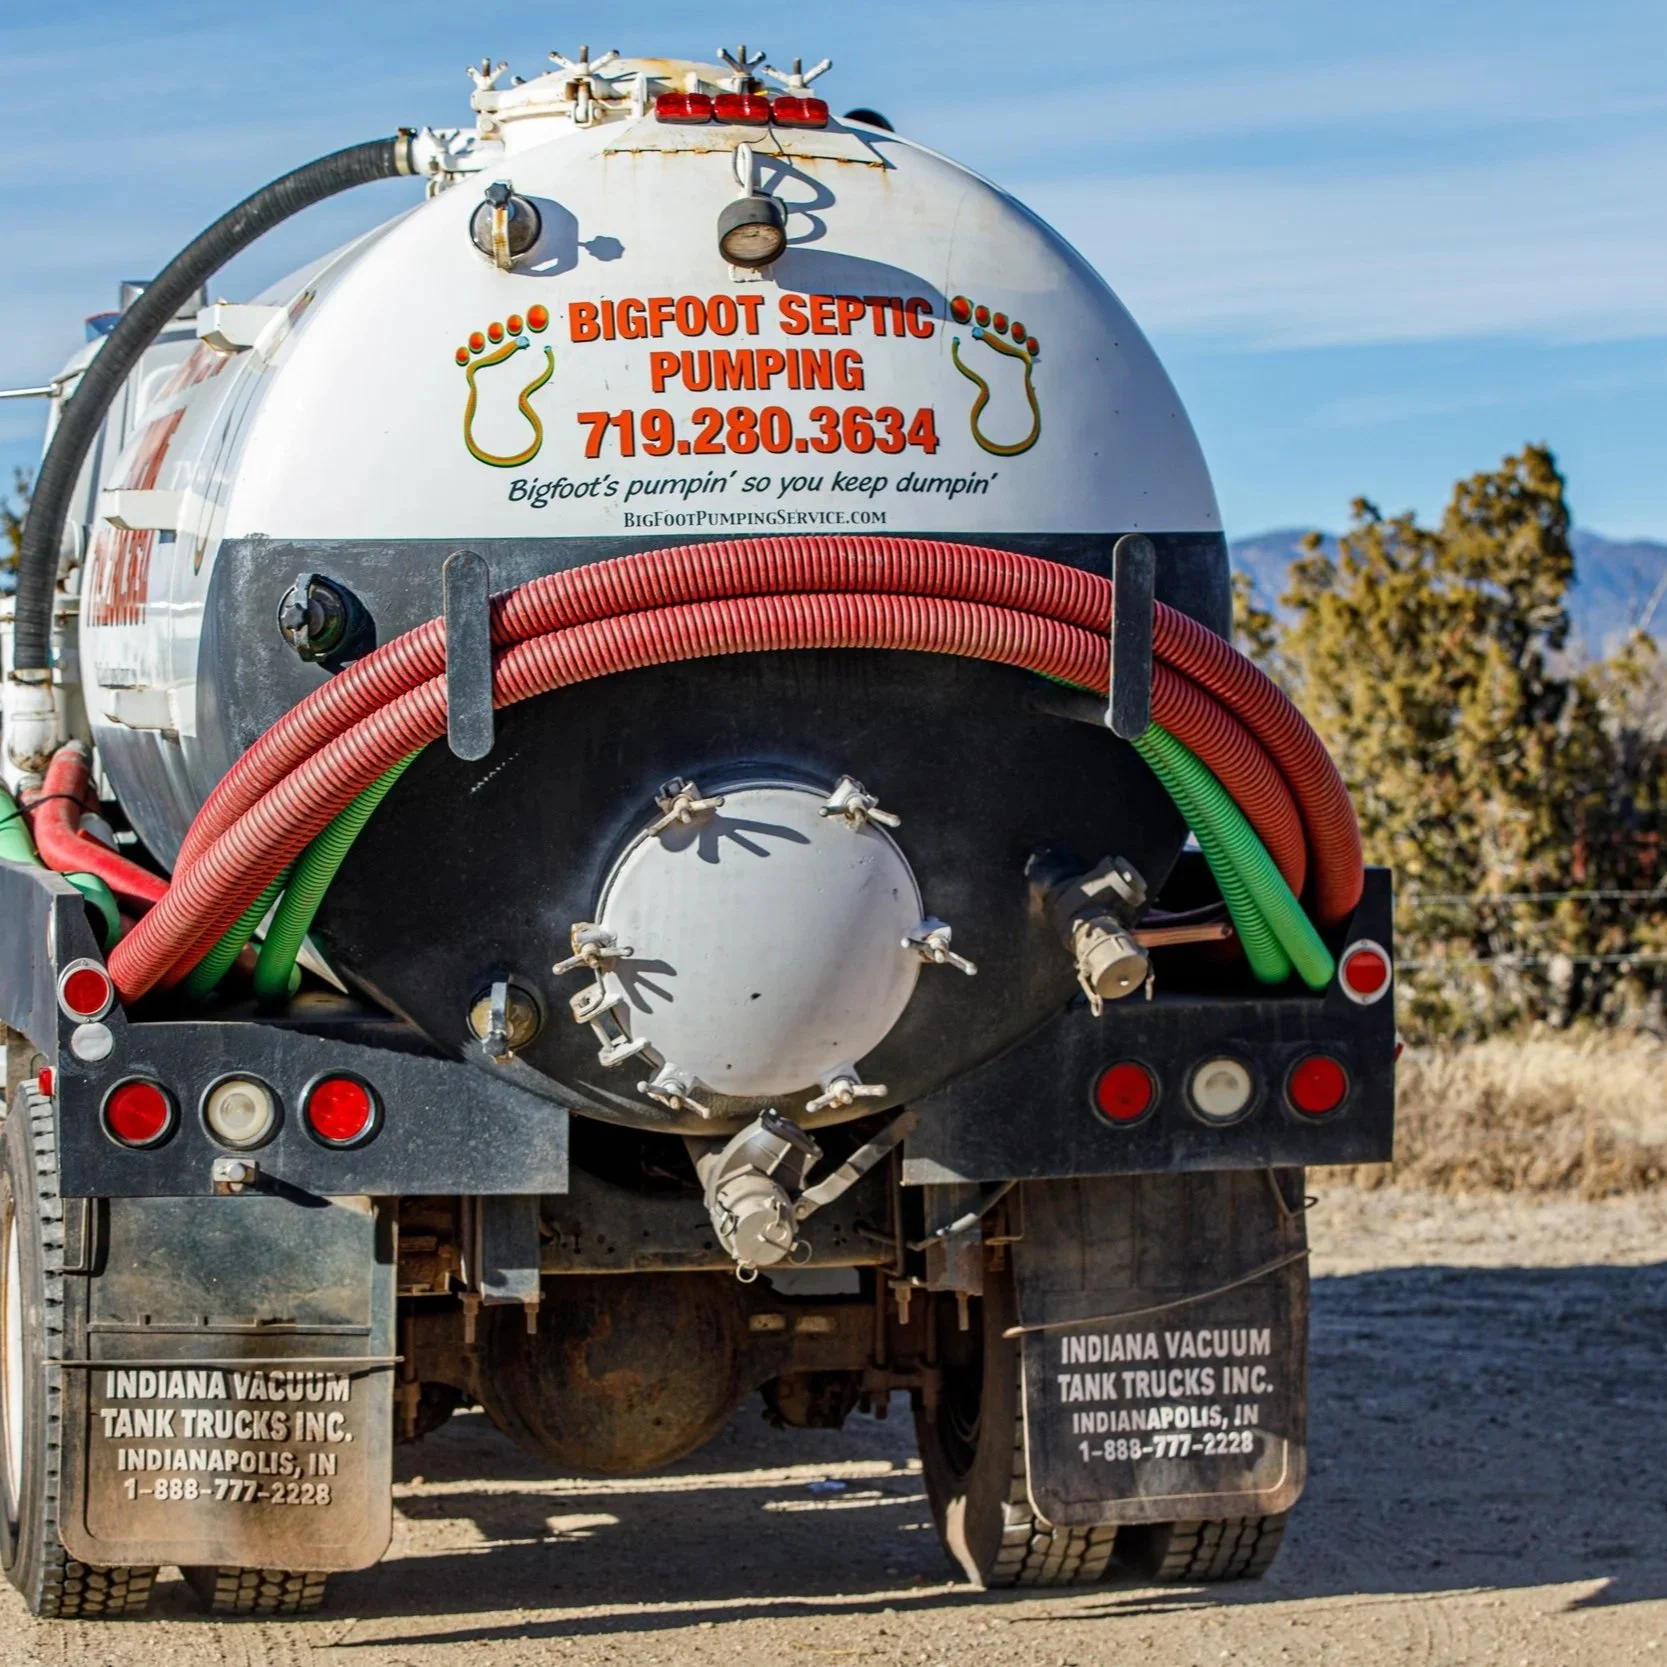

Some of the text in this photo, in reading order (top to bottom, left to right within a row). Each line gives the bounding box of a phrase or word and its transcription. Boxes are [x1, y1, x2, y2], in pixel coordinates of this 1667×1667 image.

[568, 294, 935, 343] BIGFOOT SEPTIC
[650, 347, 865, 393] PUMPING
[577, 406, 938, 458] 719.280.3634
[507, 472, 619, 508] Bigfoot's
[742, 477, 771, 493] so
[778, 475, 824, 500] you
[830, 473, 889, 499] keep
[1061, 1328, 1271, 1364] INDIANA VACUUM
[106, 1370, 351, 1402] INDIANA VACUUM
[1057, 1365, 1274, 1403] TANK TRUCKS INC.
[101, 1408, 353, 1443] TANK TRUCKS INC.
[1073, 1404, 1259, 1434] INDIANAPOLIS, IN
[117, 1448, 338, 1479] INDIANAPOLIS, IN
[1078, 1431, 1254, 1463] 1-888-777-2228
[123, 1478, 332, 1506] 1-888-777-2228
